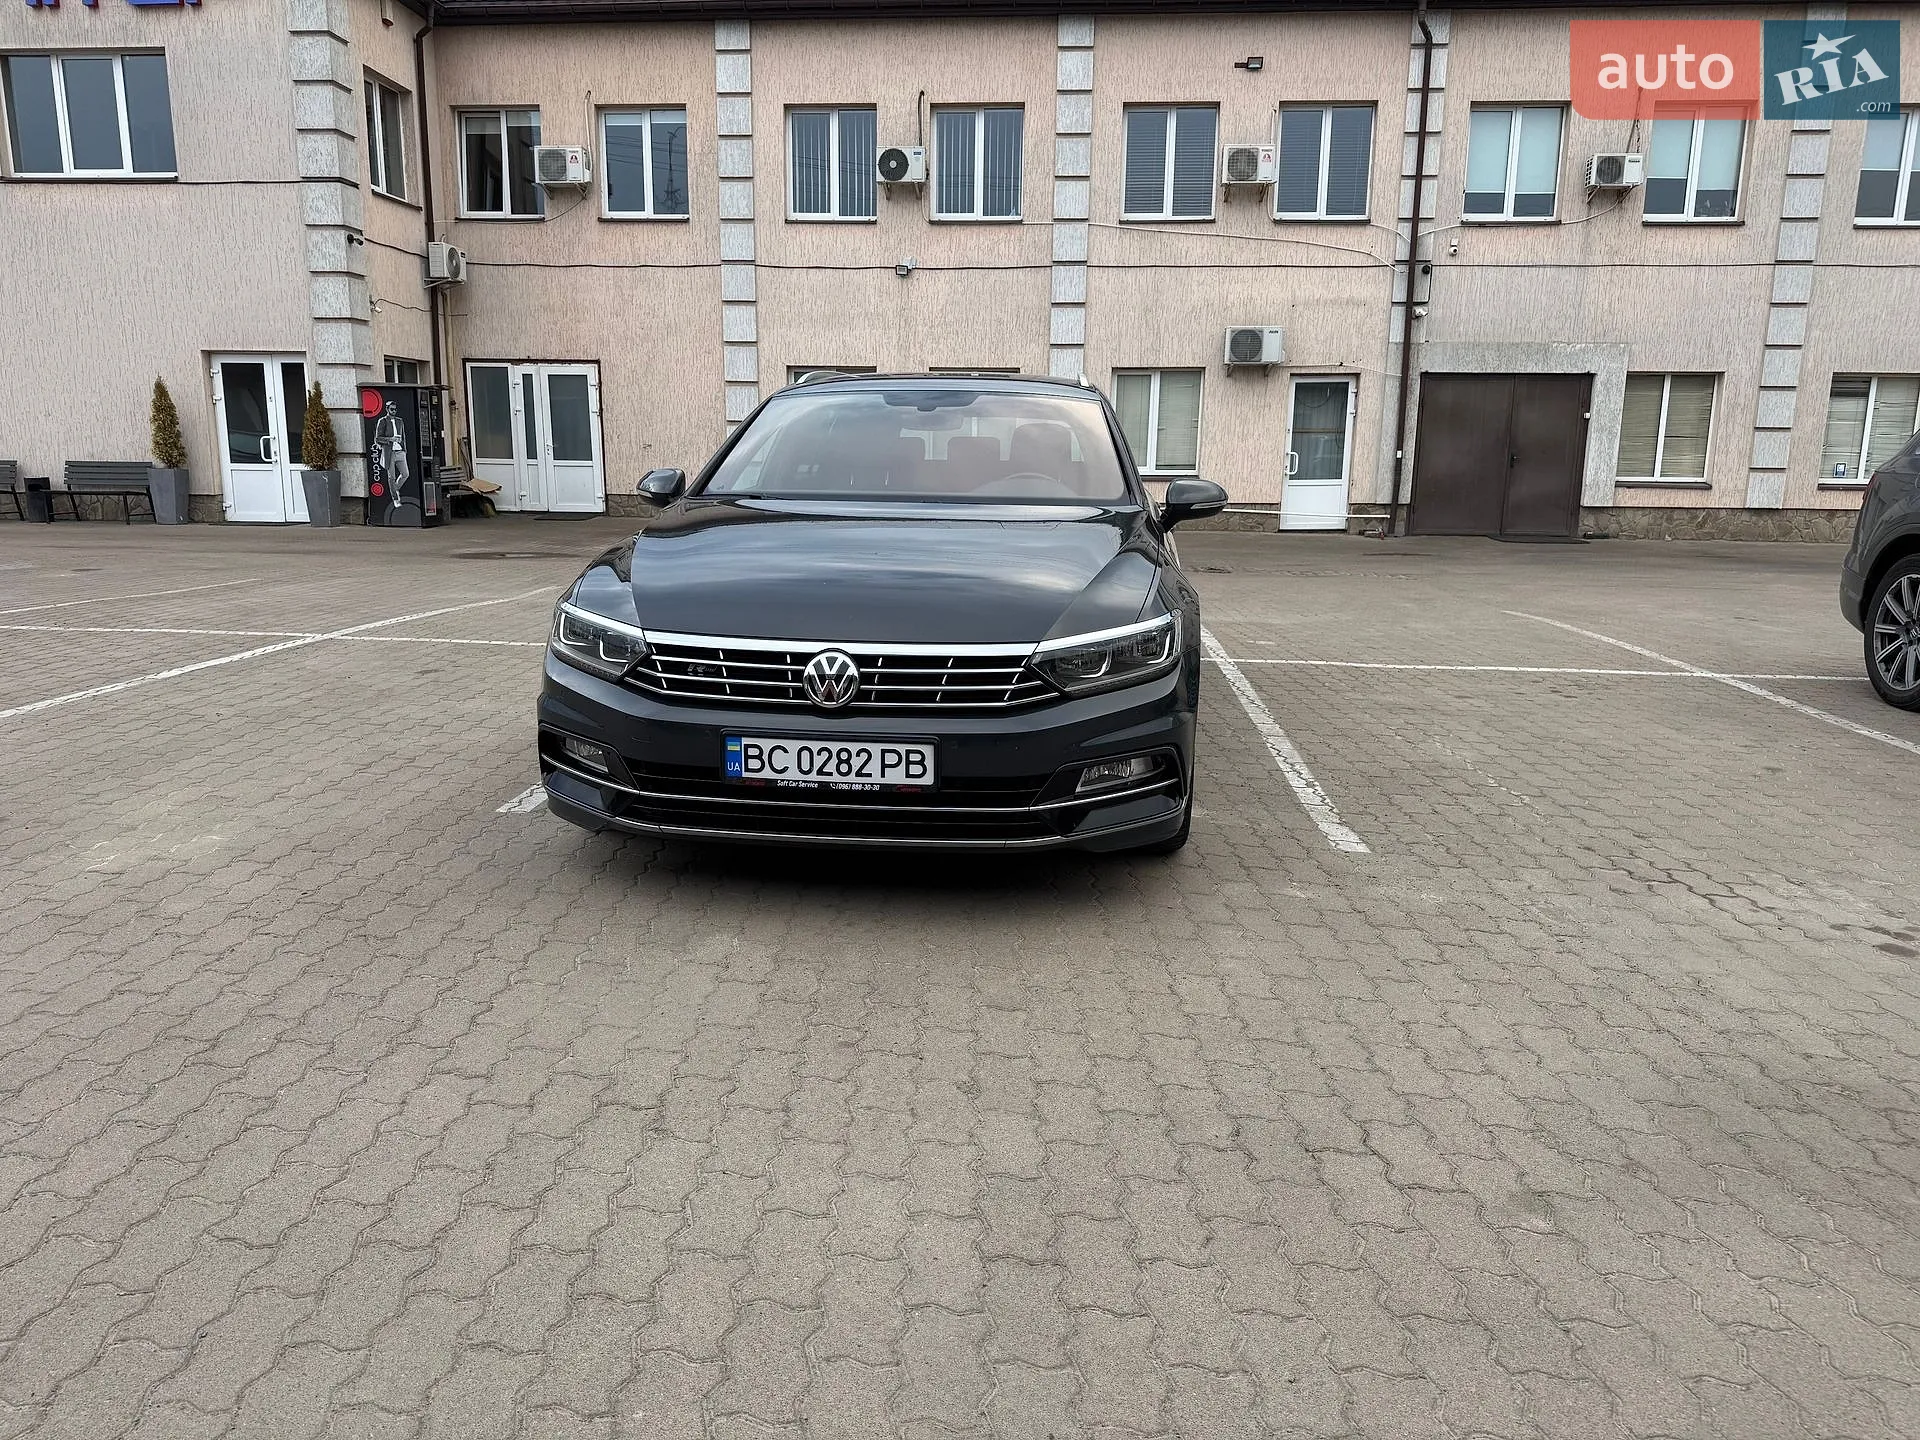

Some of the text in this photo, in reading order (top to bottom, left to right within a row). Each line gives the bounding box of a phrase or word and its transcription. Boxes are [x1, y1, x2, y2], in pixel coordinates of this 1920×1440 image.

[727, 761, 741, 772] UA
[743, 743, 928, 779] BC 0282 PB
[799, 780, 819, 788] Service
